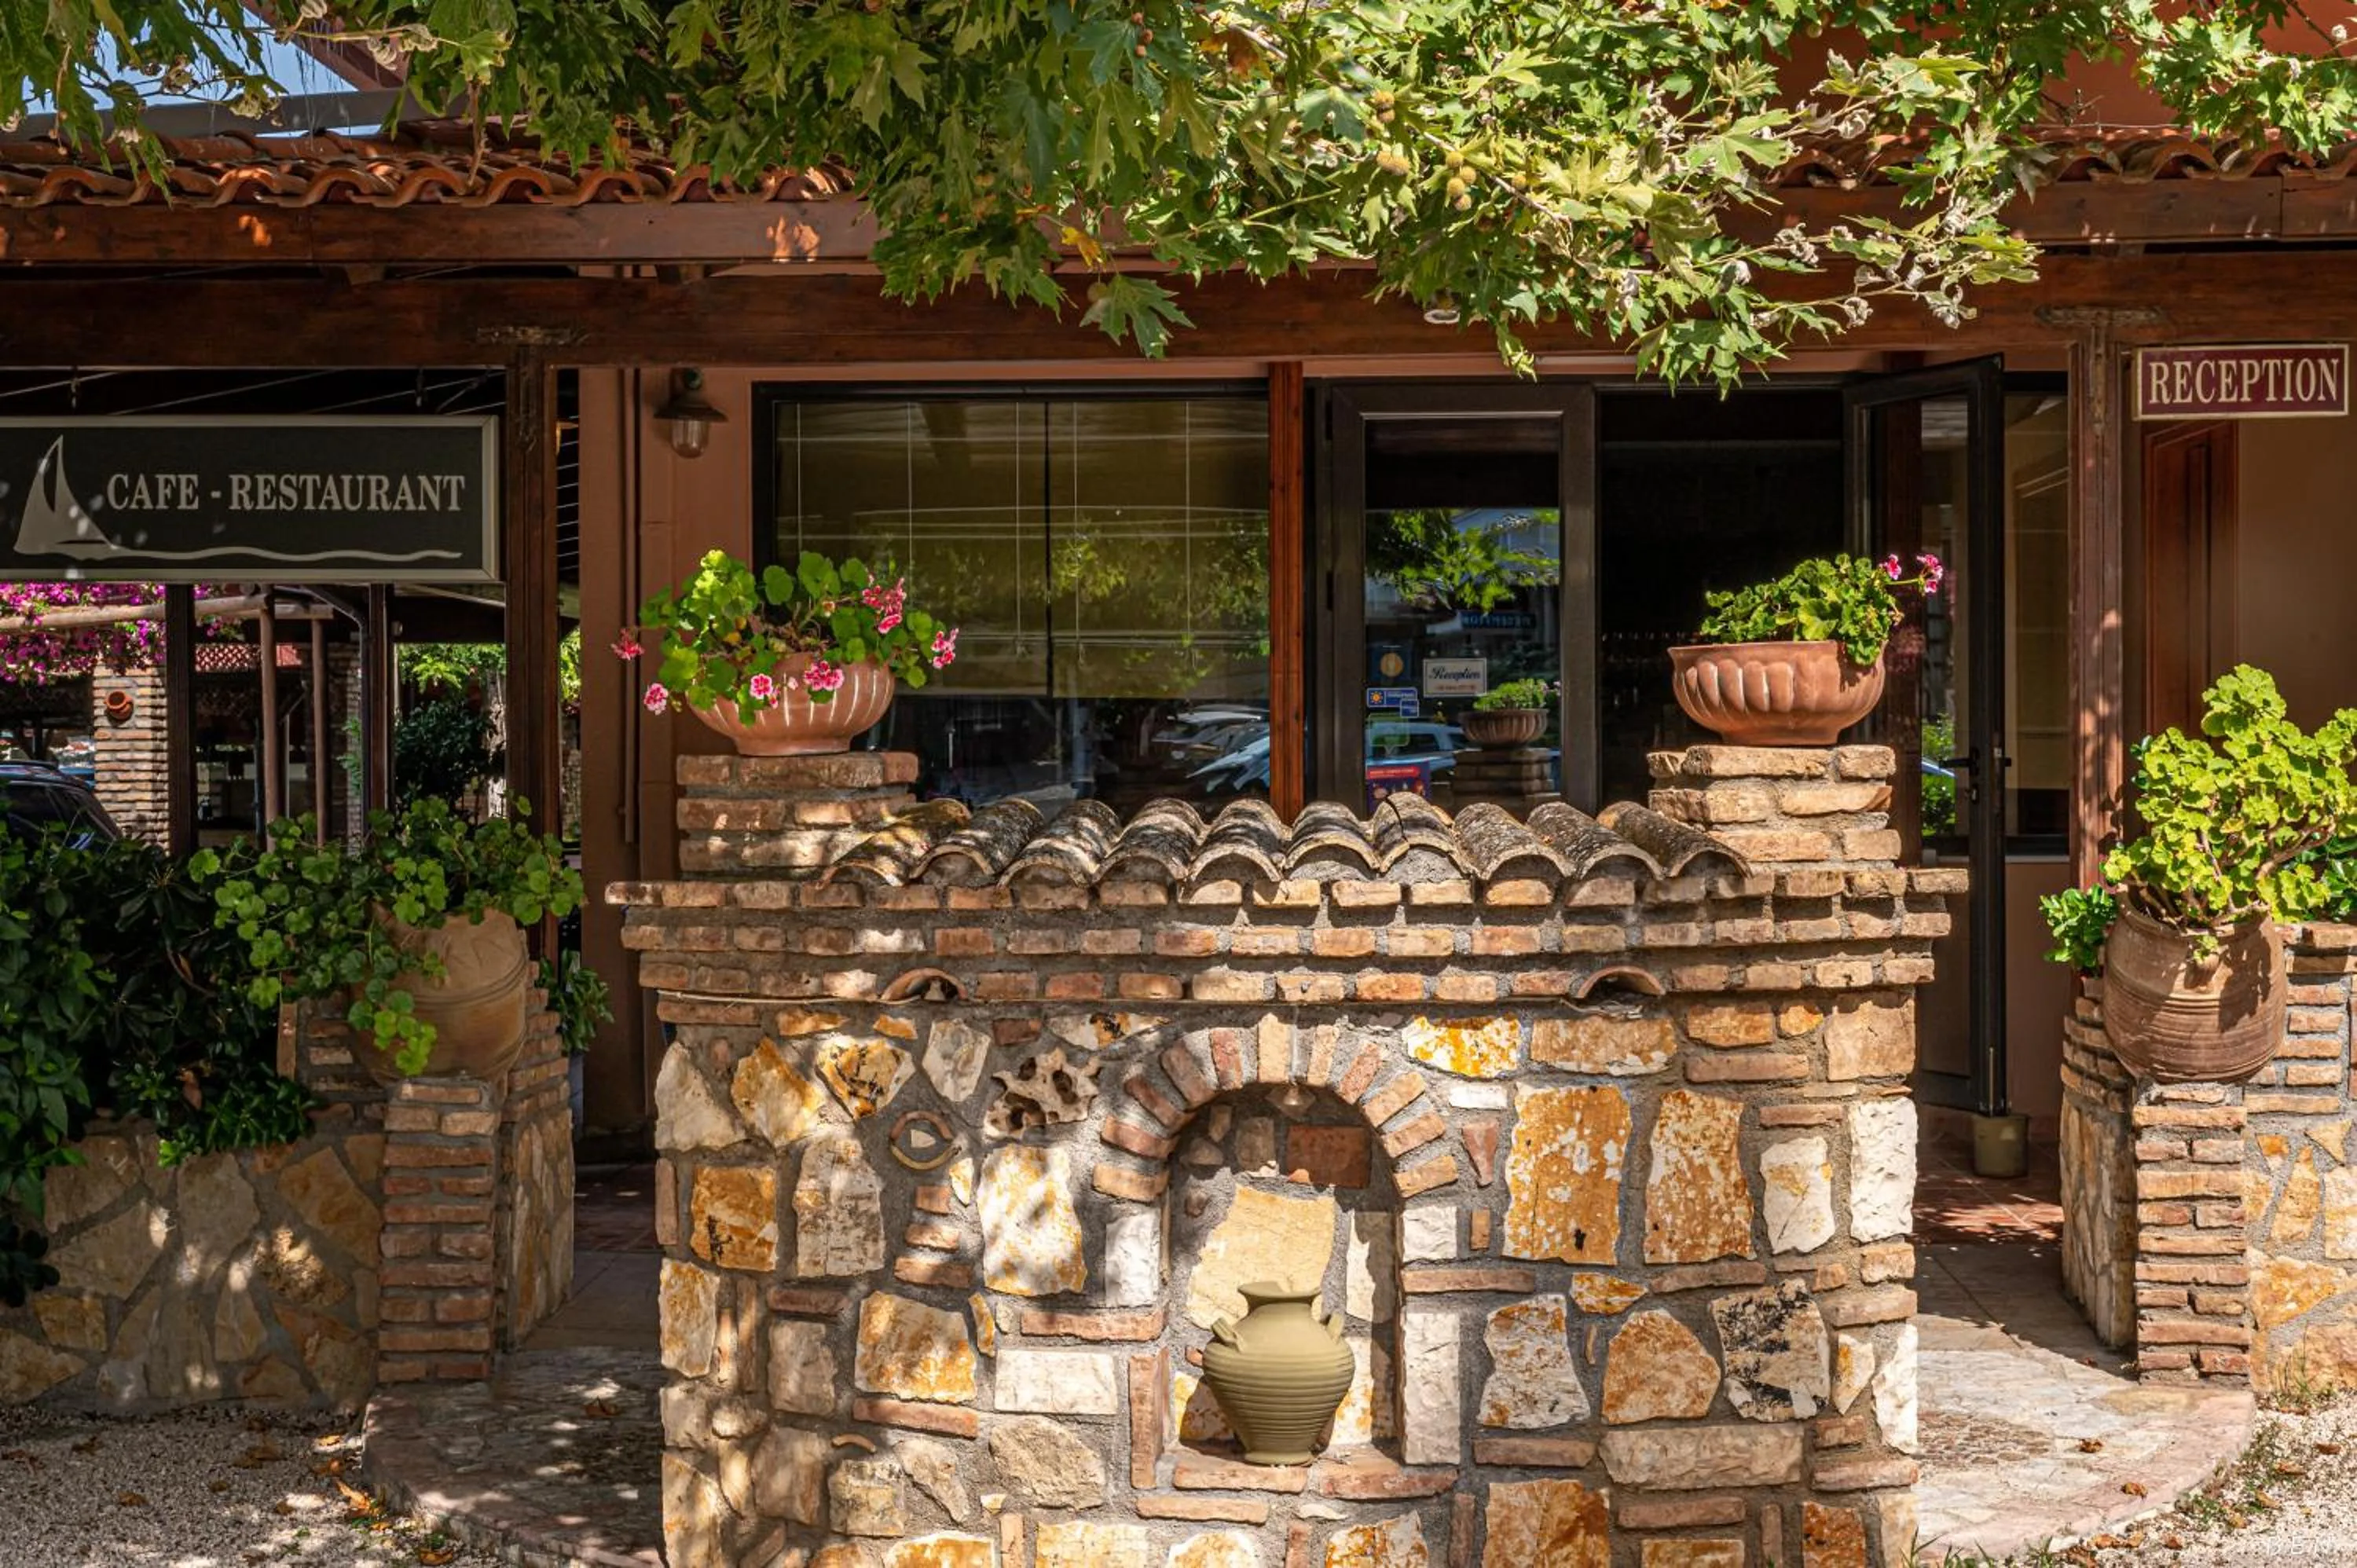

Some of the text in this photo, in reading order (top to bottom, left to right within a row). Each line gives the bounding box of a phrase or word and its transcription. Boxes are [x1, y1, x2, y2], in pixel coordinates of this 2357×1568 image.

[2149, 358, 2339, 405] RECEPTION
[106, 474, 199, 511] CAFE
[229, 474, 465, 511] RESTAURANT
